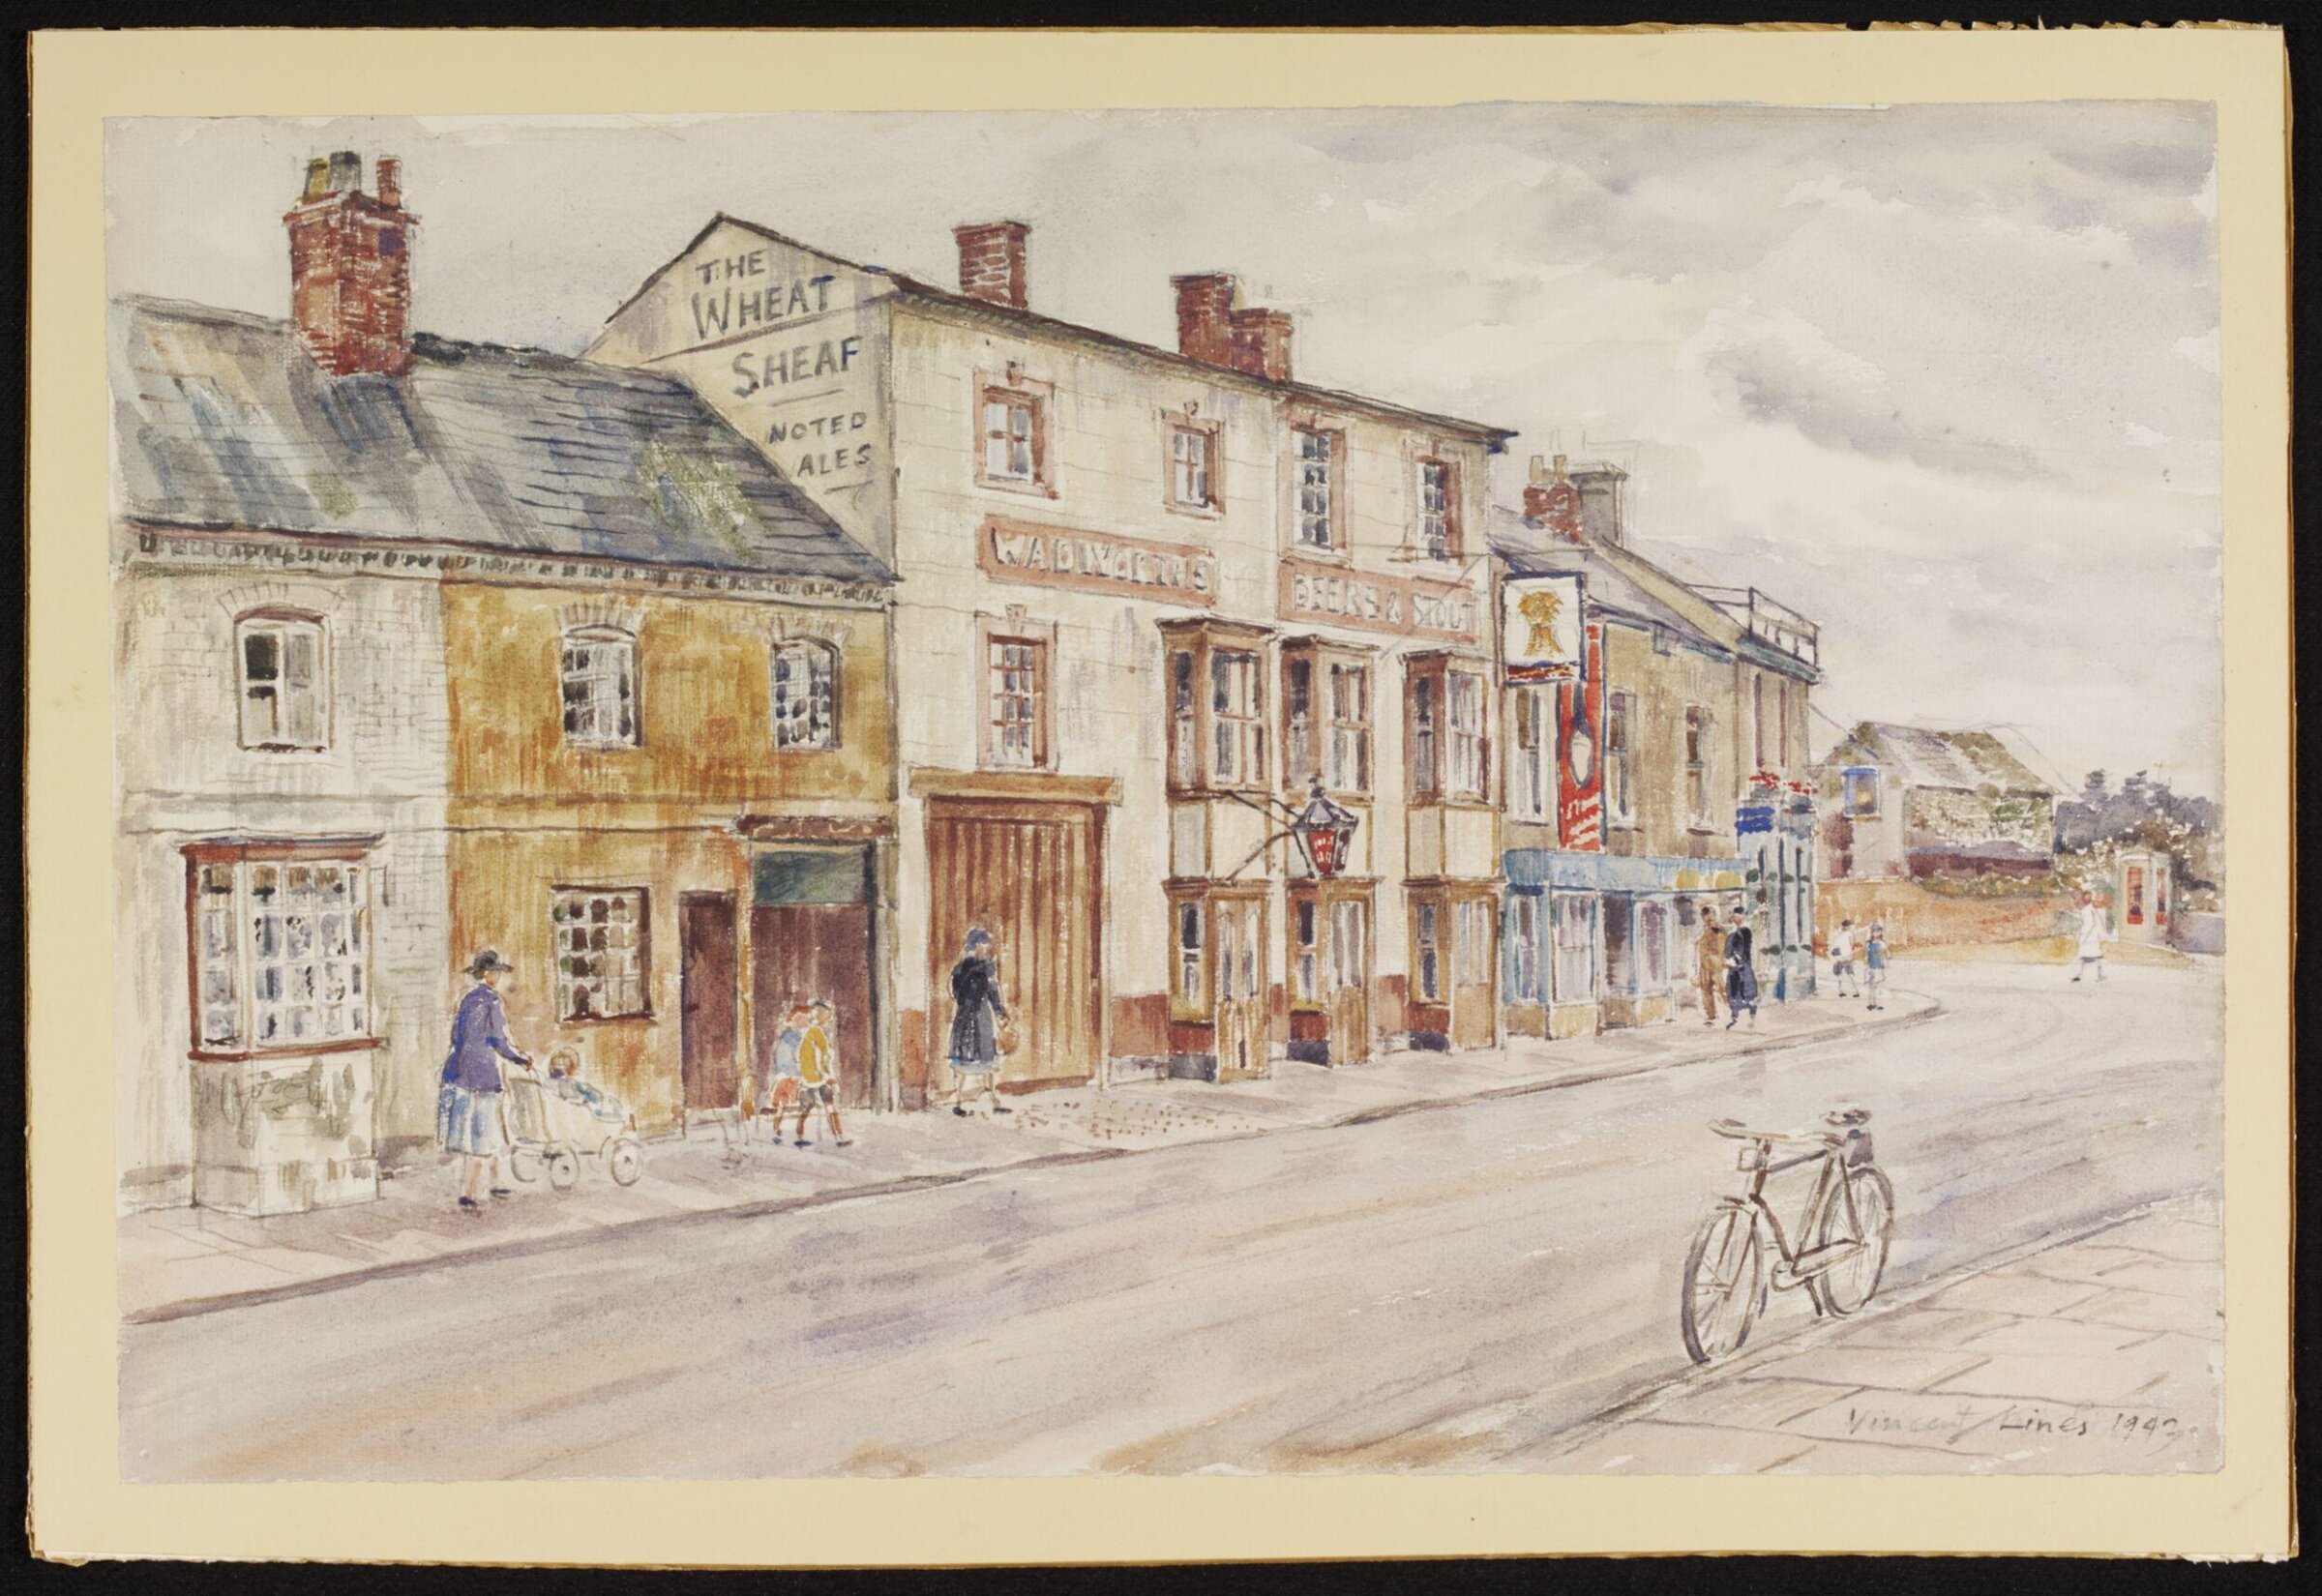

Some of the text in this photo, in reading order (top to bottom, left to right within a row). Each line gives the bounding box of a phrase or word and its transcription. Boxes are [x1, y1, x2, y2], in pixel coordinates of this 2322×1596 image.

[697, 250, 765, 284] THE
[692, 276, 835, 340] WHEAT
[732, 336, 863, 398] SHEAF
[769, 412, 867, 443] NOTED
[798, 444, 870, 477] ALES
[2000, 1406, 2087, 1435] Lines
